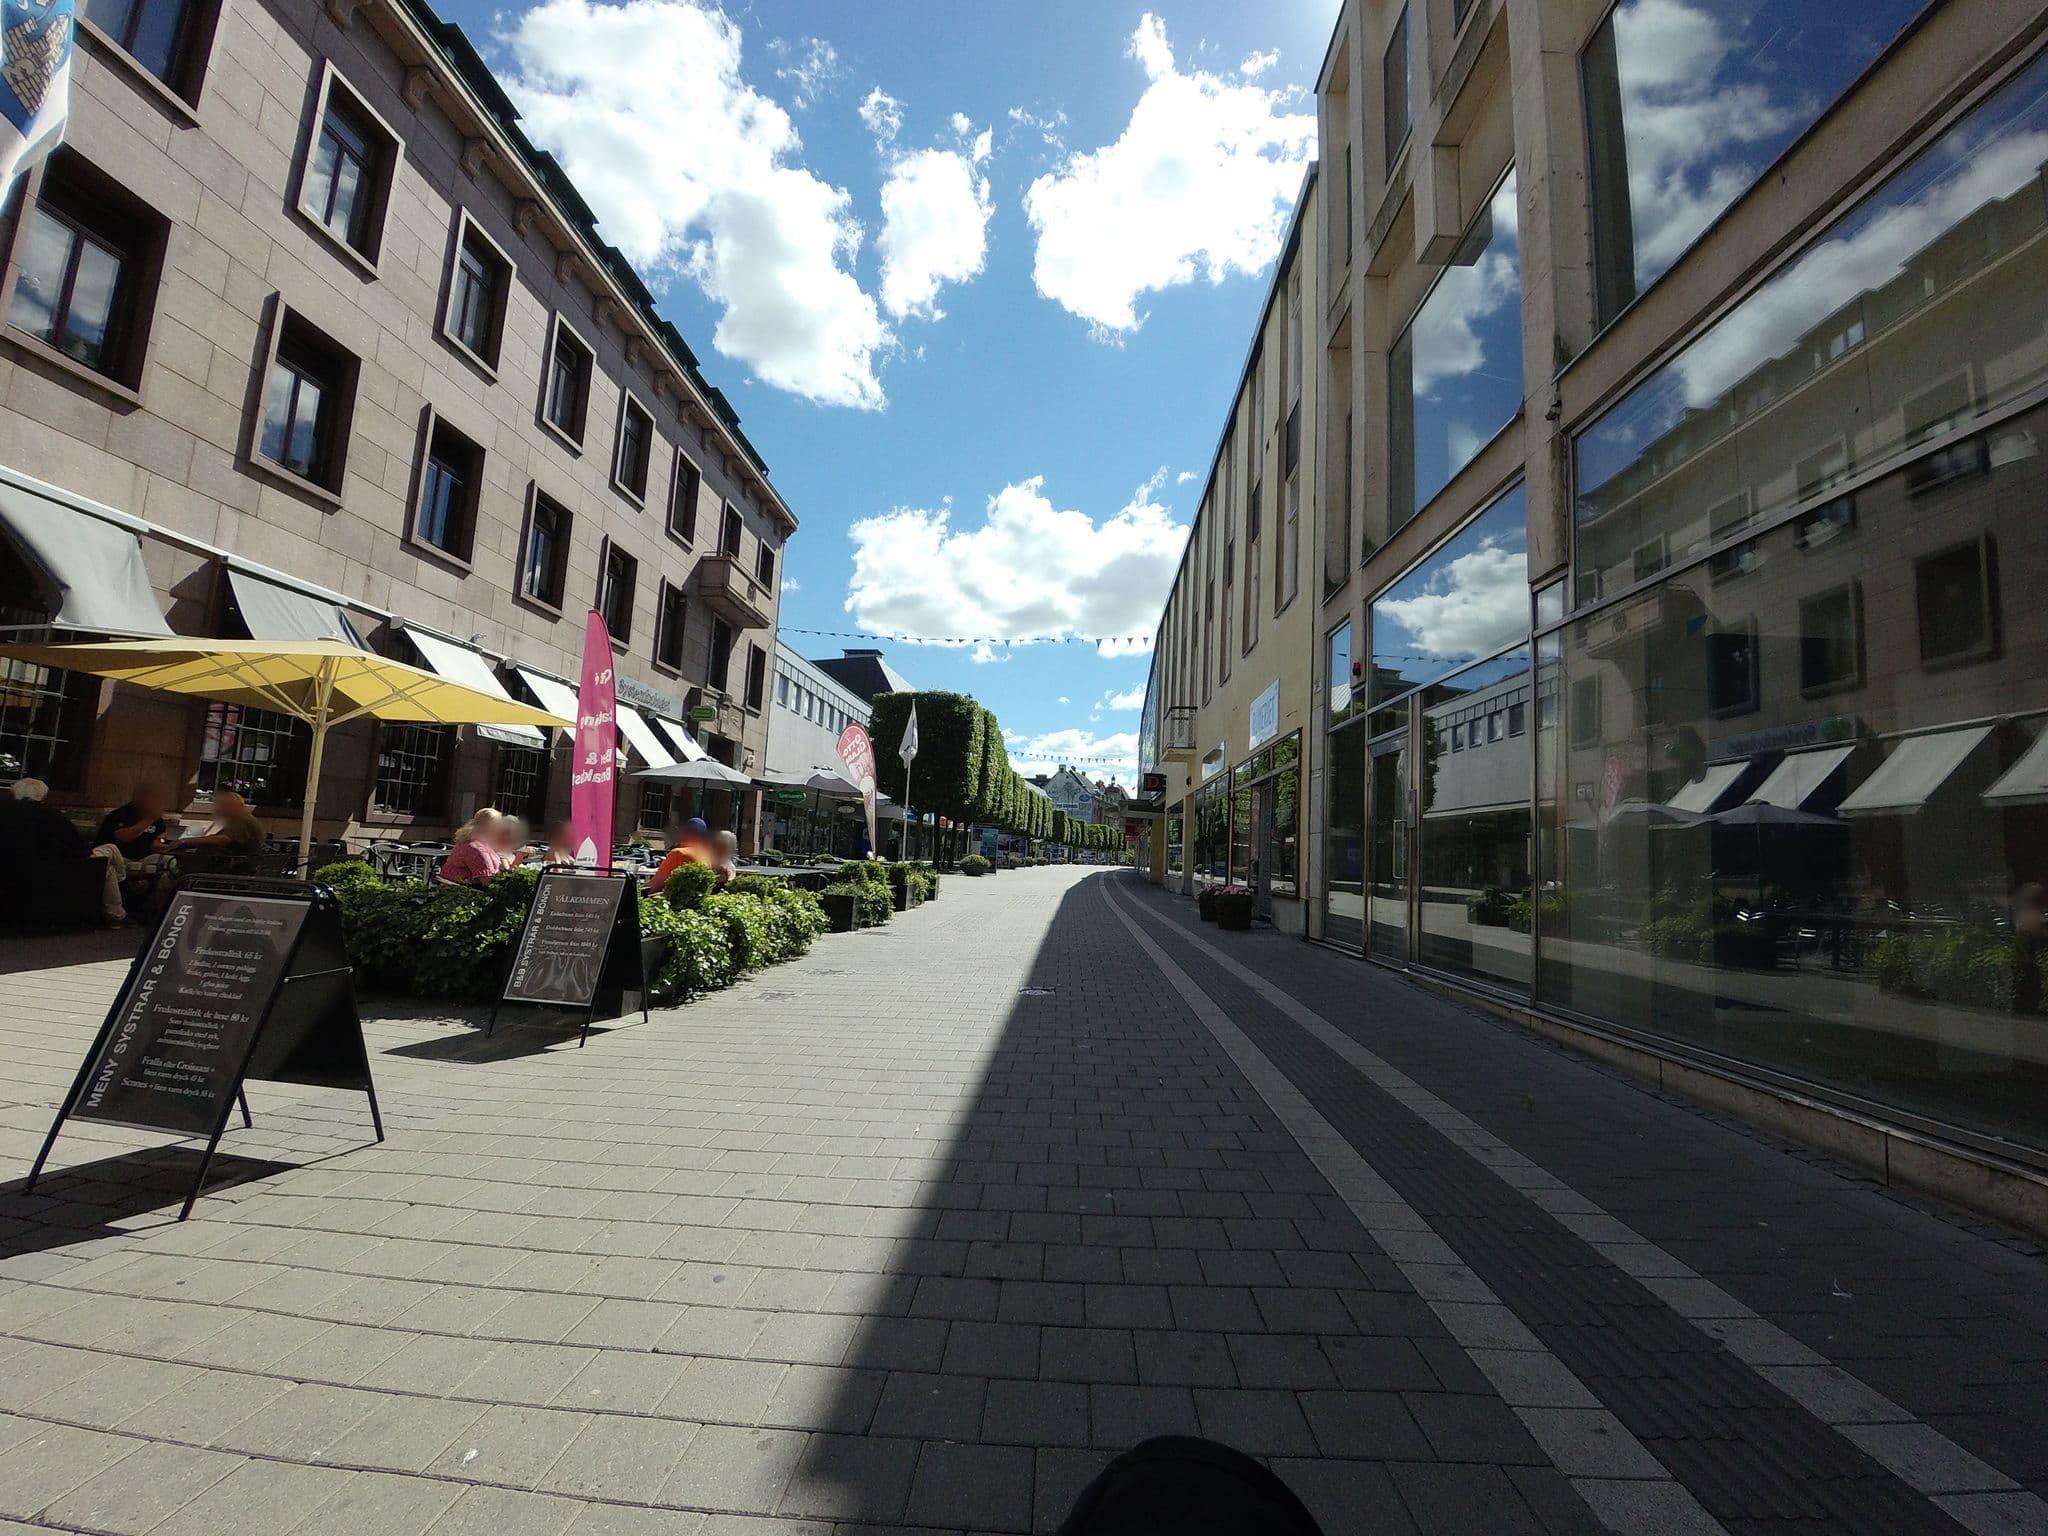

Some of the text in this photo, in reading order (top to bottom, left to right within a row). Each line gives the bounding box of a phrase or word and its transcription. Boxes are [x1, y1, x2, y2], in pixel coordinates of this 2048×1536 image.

[521, 925, 540, 967] SYSTRAR
[536, 884, 553, 915] BÖNOR
[86, 904, 192, 1108] MENY SYSTRAR & BÖNOR
